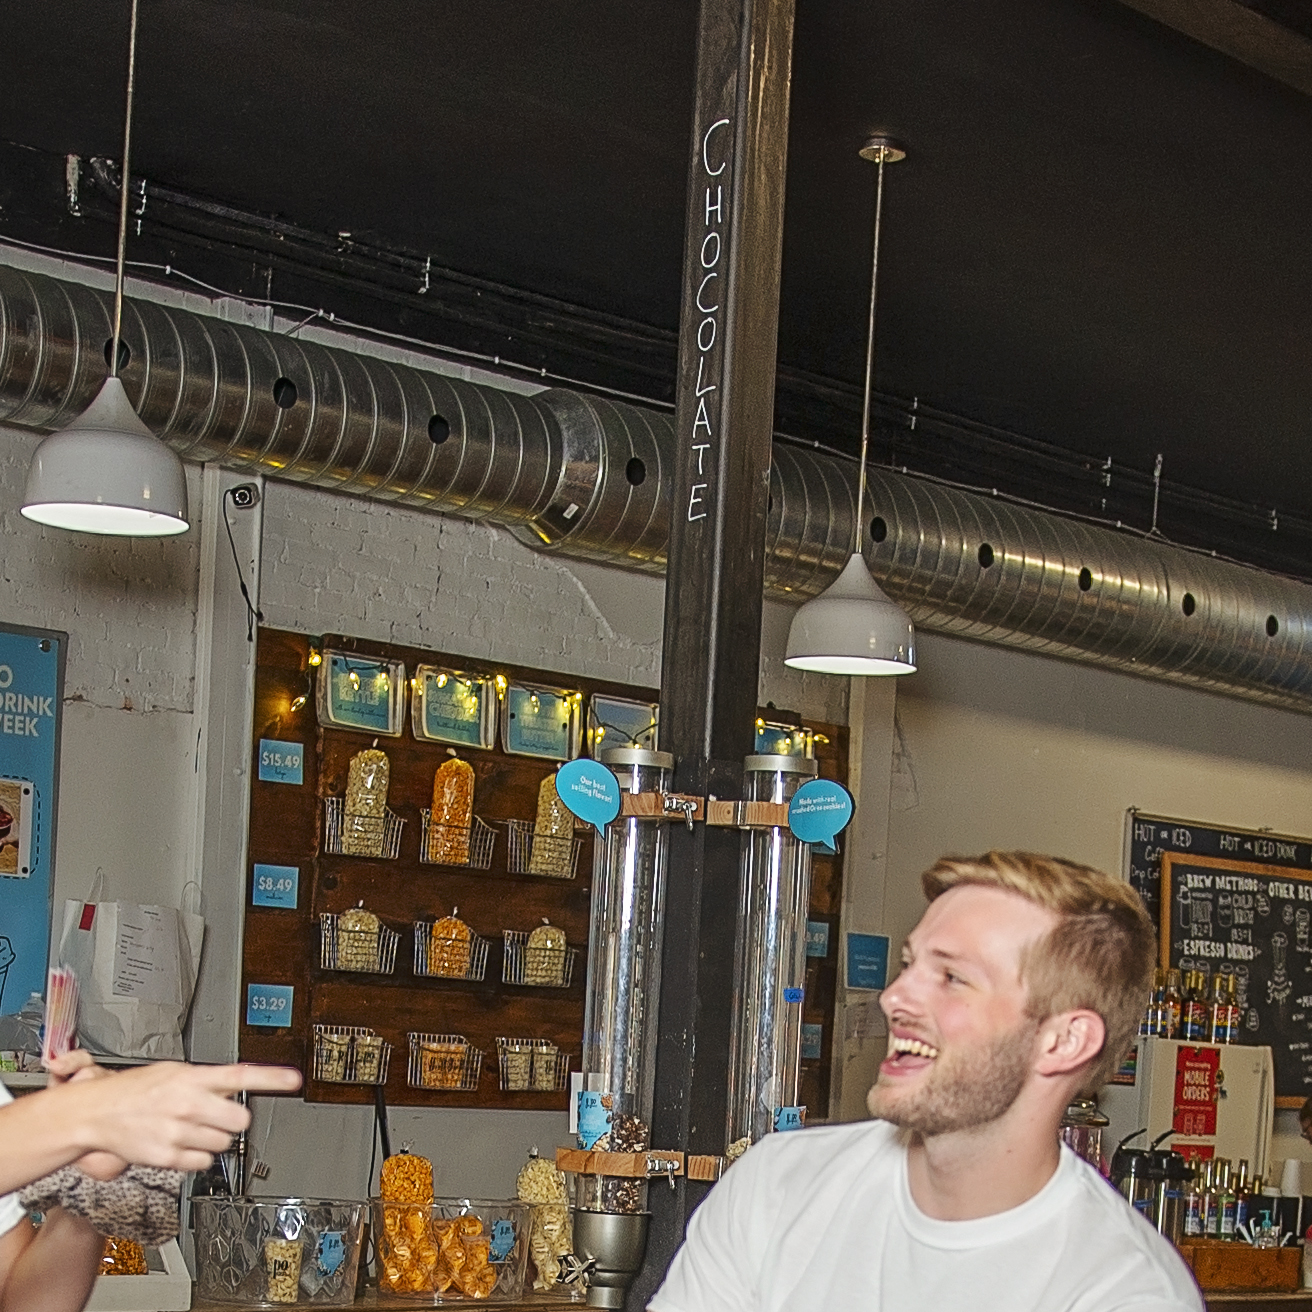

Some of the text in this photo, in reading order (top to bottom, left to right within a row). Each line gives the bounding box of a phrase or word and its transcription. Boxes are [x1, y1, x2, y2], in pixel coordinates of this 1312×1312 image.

[688, 118, 730, 522] CHOCOLATE
[261, 751, 300, 768] $15.49
[593, 779, 606, 791] best
[1134, 823, 1156, 842] HOT
[1171, 830, 1192, 848] ICED
[1220, 835, 1241, 851] HOT
[1254, 841, 1275, 857] ICED
[258, 876, 292, 891] $8.49
[1186, 873, 1258, 892] BREW METHODS
[1268, 882, 1295, 899] OTHER
[1183, 939, 1254, 960] ESPRESSO DRINKS
[252, 996, 286, 1011] $3.29
[1184, 1070, 1210, 1085] MOBILE
[1183, 1086, 1209, 1100] ORDERS
